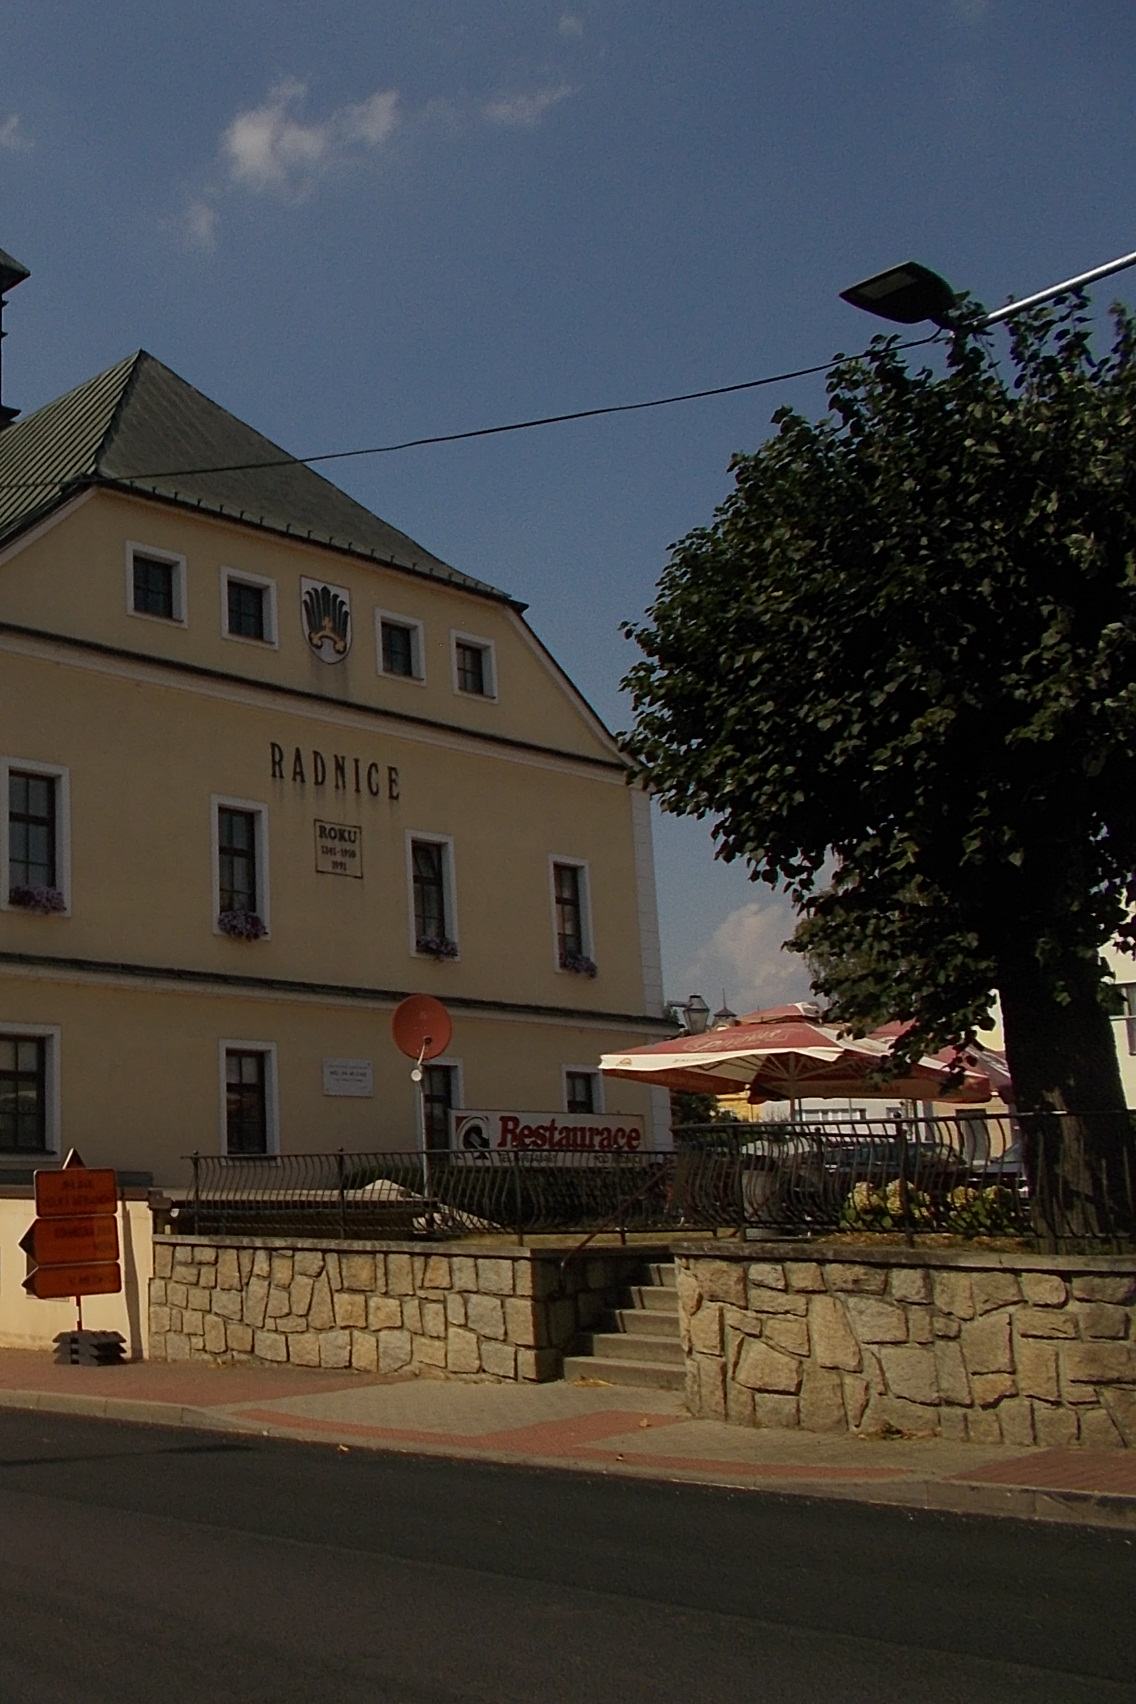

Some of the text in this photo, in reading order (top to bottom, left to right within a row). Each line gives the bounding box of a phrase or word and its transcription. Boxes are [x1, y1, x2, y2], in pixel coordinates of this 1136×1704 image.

[270, 742, 400, 800] RADNICE
[319, 825, 357, 843] ROKU
[498, 1116, 641, 1150] Restaurace
